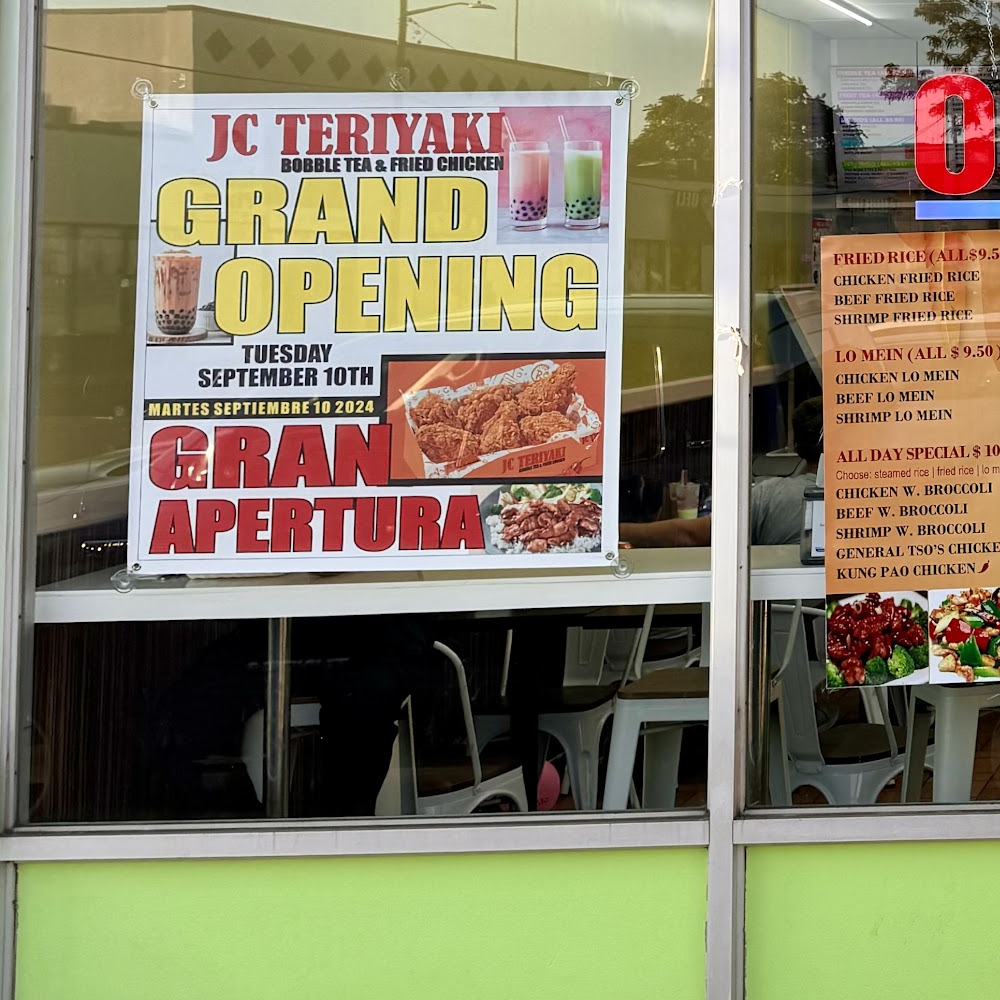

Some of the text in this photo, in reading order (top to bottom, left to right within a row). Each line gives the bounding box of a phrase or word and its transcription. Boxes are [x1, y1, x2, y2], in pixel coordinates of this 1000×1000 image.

[206, 112, 505, 162] JC TERIYAKI
[281, 156, 504, 173] BOBBLE TEA & FRIED CHICKEN
[156, 176, 488, 247] GRAND
[834, 252, 884, 265] FRIED
[888, 251, 926, 263] RICE
[834, 271, 980, 286] CHICKEN FRIED RICE
[213, 252, 599, 337] OPENING
[834, 291, 955, 305] BEEF FRIED RICE
[834, 310, 973, 325] SHRIMP FRIED RICE
[242, 344, 332, 364] TUESDAY
[836, 350, 856, 362] LO
[862, 348, 903, 361] MEIN
[198, 367, 373, 387] SEPTEMBER 10TH
[836, 370, 959, 385] CHICKEN LO MEIN
[836, 390, 934, 404] BEEF LO MEIN
[149, 400, 374, 416] MARTES SEPTIEMBRE 10 2024
[836, 409, 952, 424] SHRIMP LO MEIN
[148, 423, 392, 490] GRAN
[502, 458, 514, 474] JC
[518, 447, 566, 468] TERIYAKI
[837, 450, 868, 463] ALL
[870, 448, 903, 461] DAY
[907, 446, 969, 460] SPECIAL
[836, 470, 872, 480] Choose:
[875, 468, 911, 478] steamed
[914, 467, 929, 477] rice
[937, 465, 955, 476] fried
[959, 464, 974, 475] rice
[982, 464, 989, 474] lo
[836, 482, 992, 499] CHICKEN W. BROCCOLI
[836, 504, 968, 520] BEEF W. BROCCOLI
[148, 494, 486, 555] APERTURA
[836, 522, 986, 540] SHRIMP W. BROCCOLI
[836, 546, 904, 559] GENERAL
[837, 563, 975, 579] KUNG PAO CHICKEN
